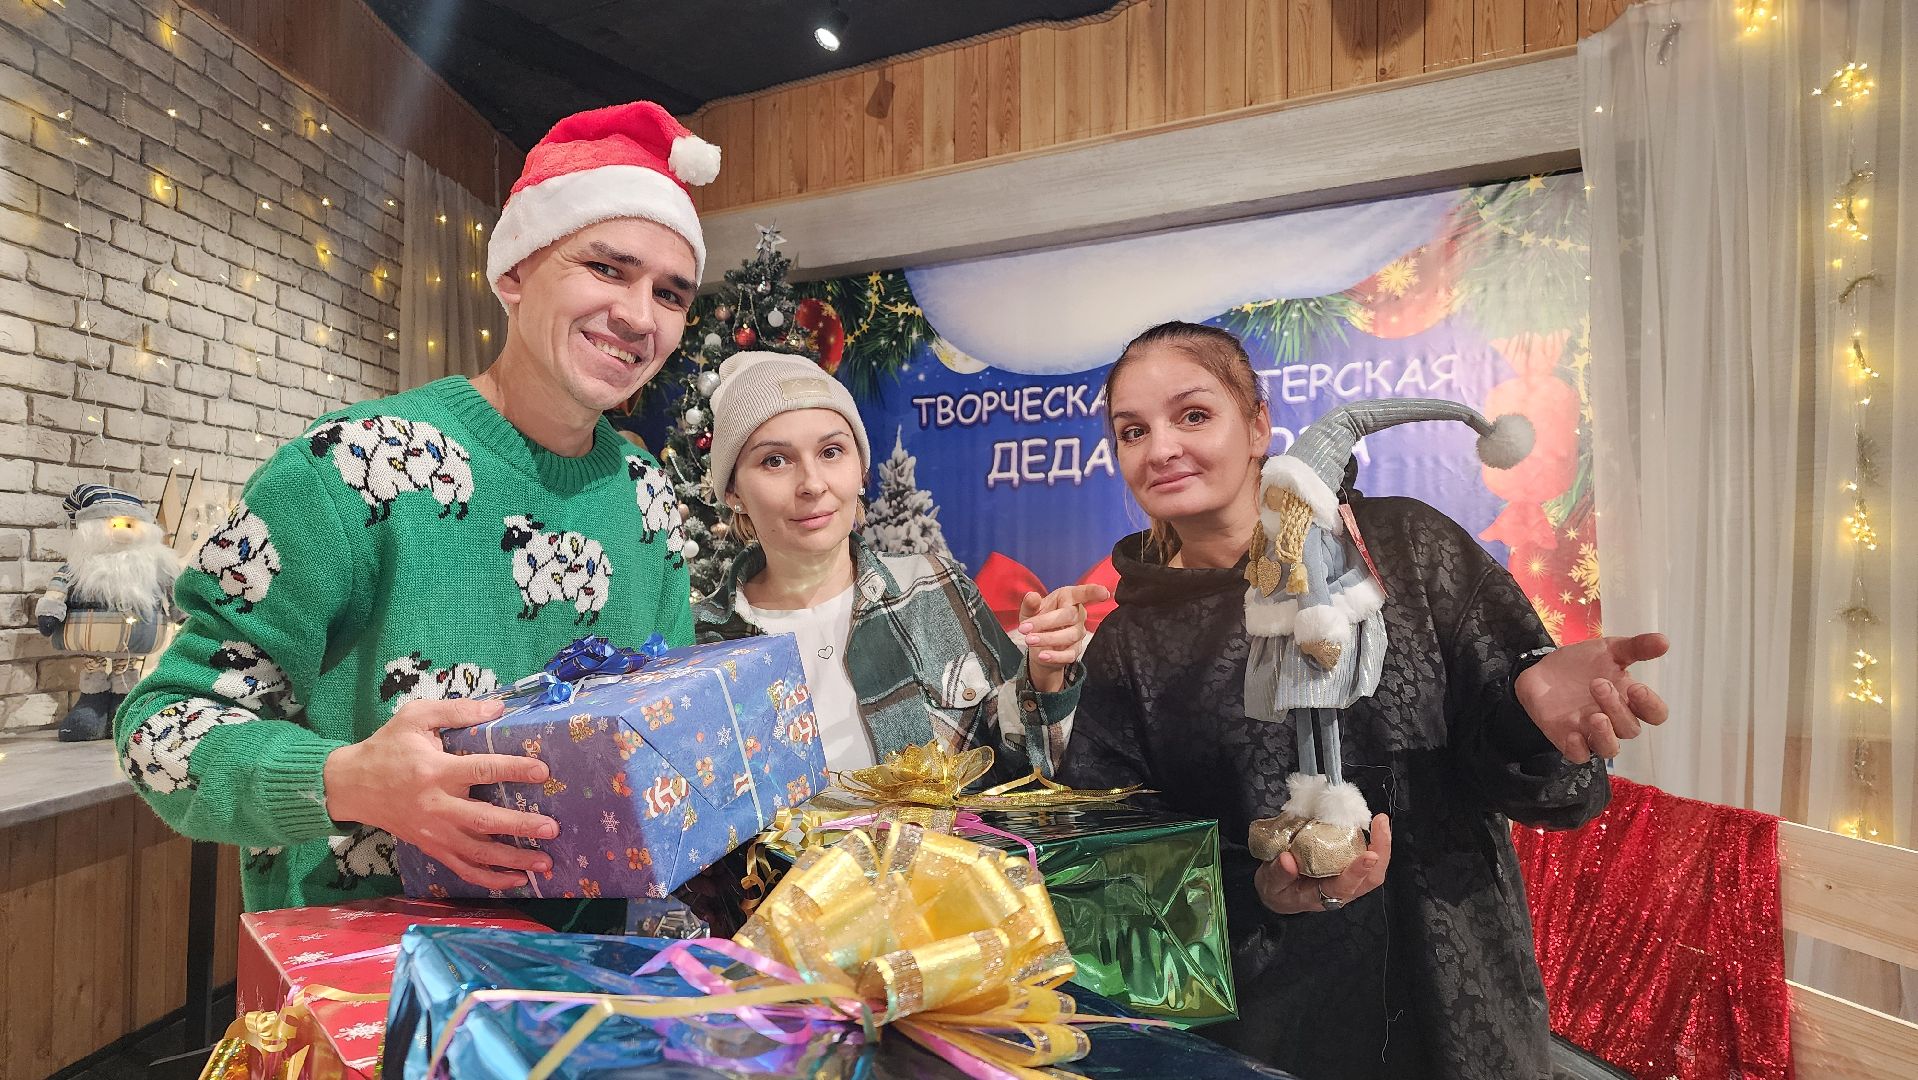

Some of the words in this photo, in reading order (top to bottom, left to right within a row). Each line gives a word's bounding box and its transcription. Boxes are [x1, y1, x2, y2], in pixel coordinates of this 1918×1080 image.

[912, 384, 1108, 427] ТВОРЧЕСКА
[1254, 354, 1459, 404] ТЕРСКАЯ
[987, 437, 1115, 488] ДЕДА
